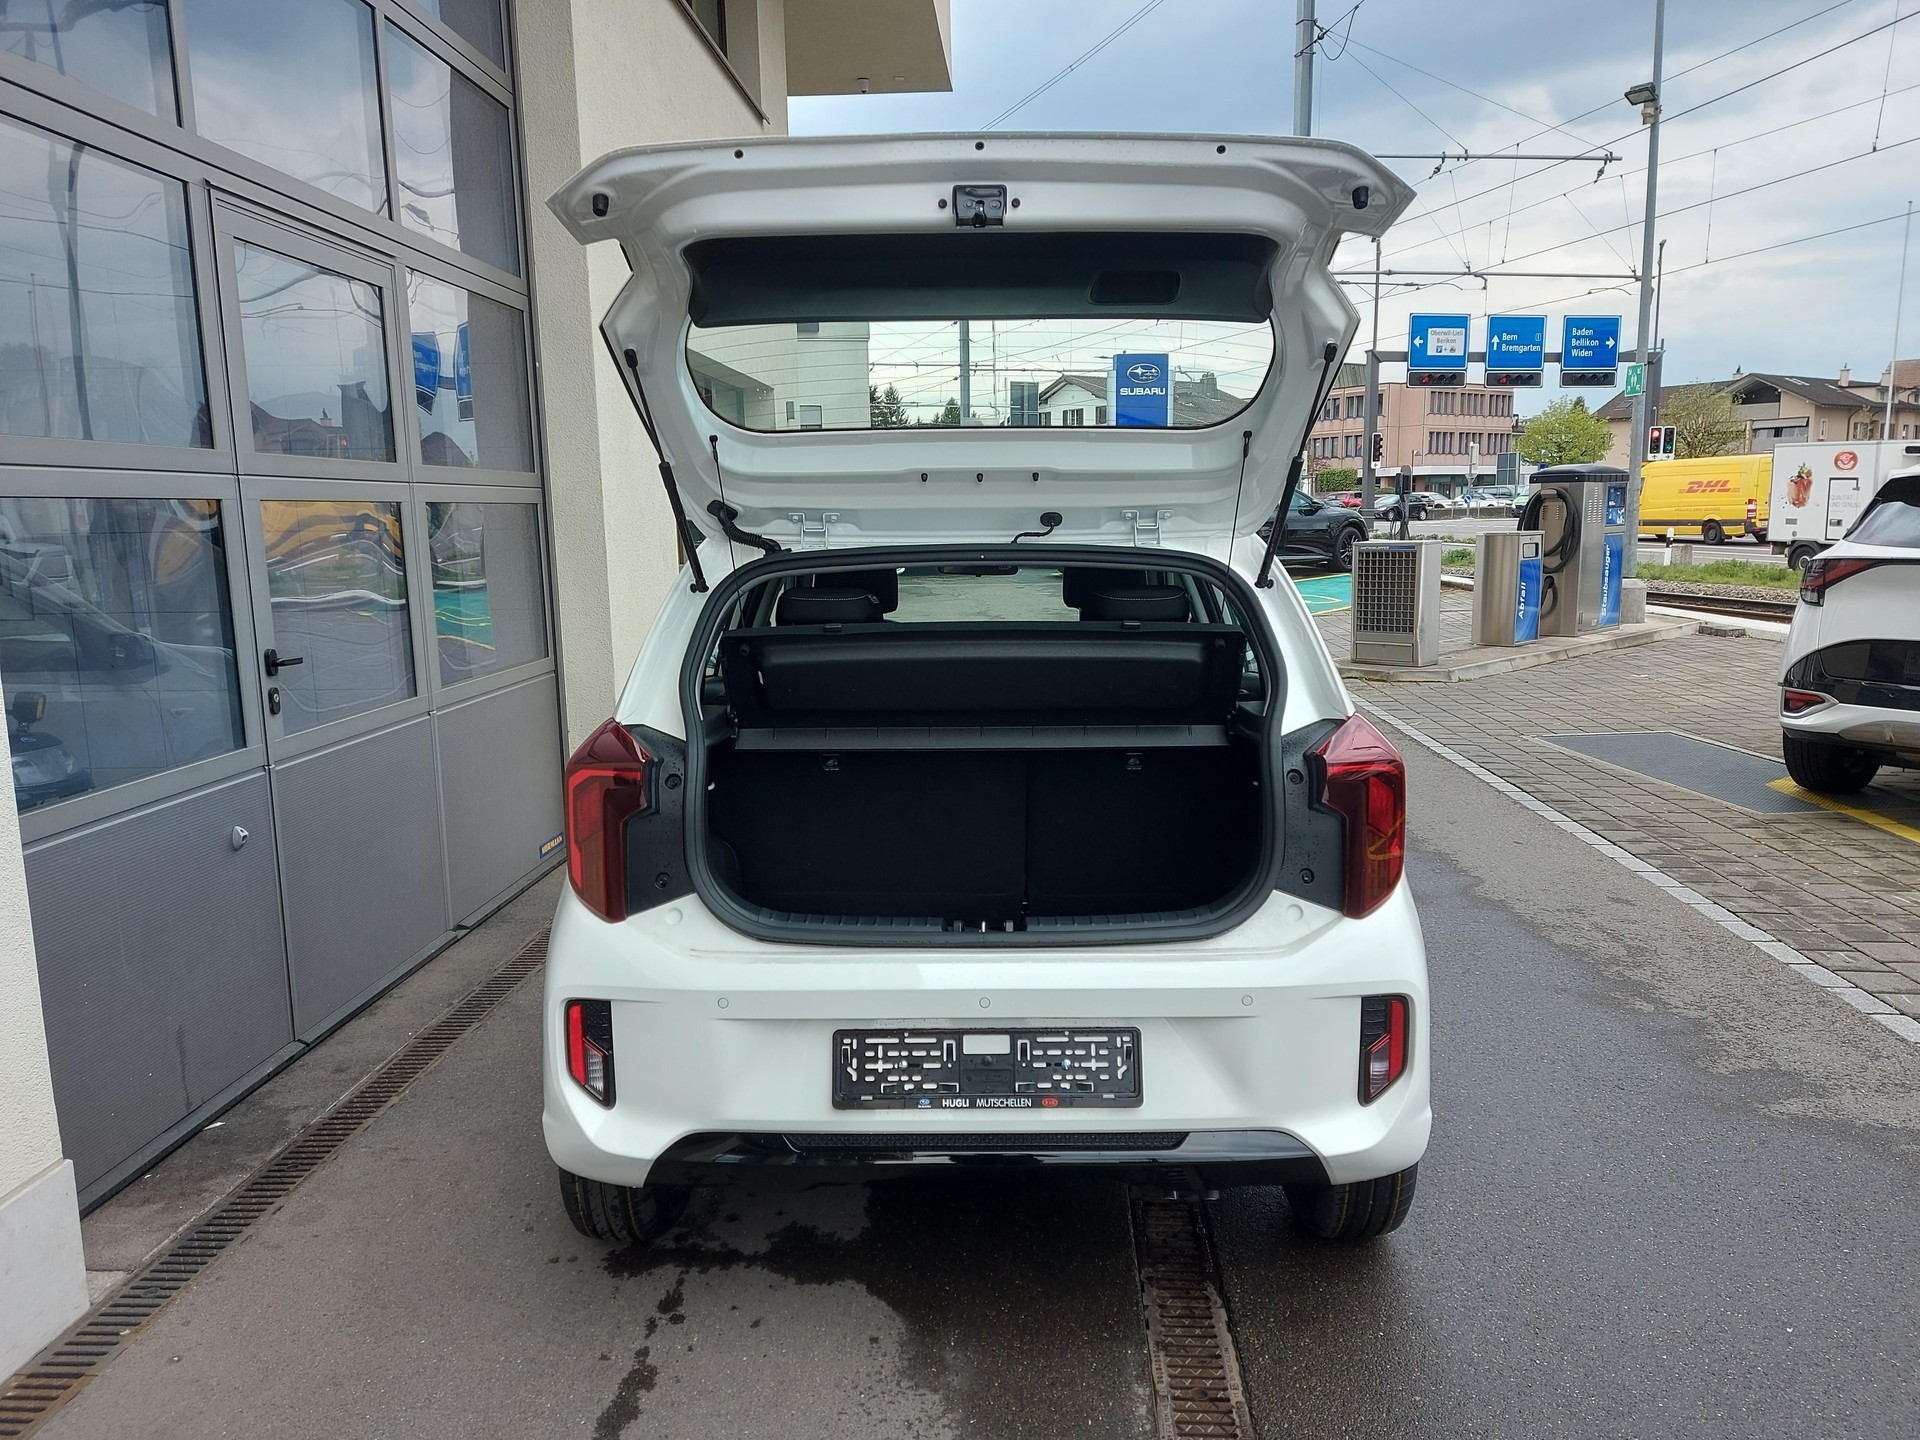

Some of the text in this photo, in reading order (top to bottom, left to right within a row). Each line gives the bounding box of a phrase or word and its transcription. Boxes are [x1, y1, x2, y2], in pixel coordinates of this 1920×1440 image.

[1502, 332, 1518, 341] Bern
[1572, 327, 1594, 336] Baden
[1571, 337, 1600, 347] Bellikon
[1501, 343, 1541, 354] Bremgarten
[1571, 348, 1593, 357] Widen
[1119, 387, 1166, 396] SUBARU
[1686, 480, 1731, 494] DHL
[1602, 544, 1611, 616] Staubsauger
[1518, 581, 1527, 620] Abfall
[976, 1098, 1032, 1108] MUTSCHELLEN
